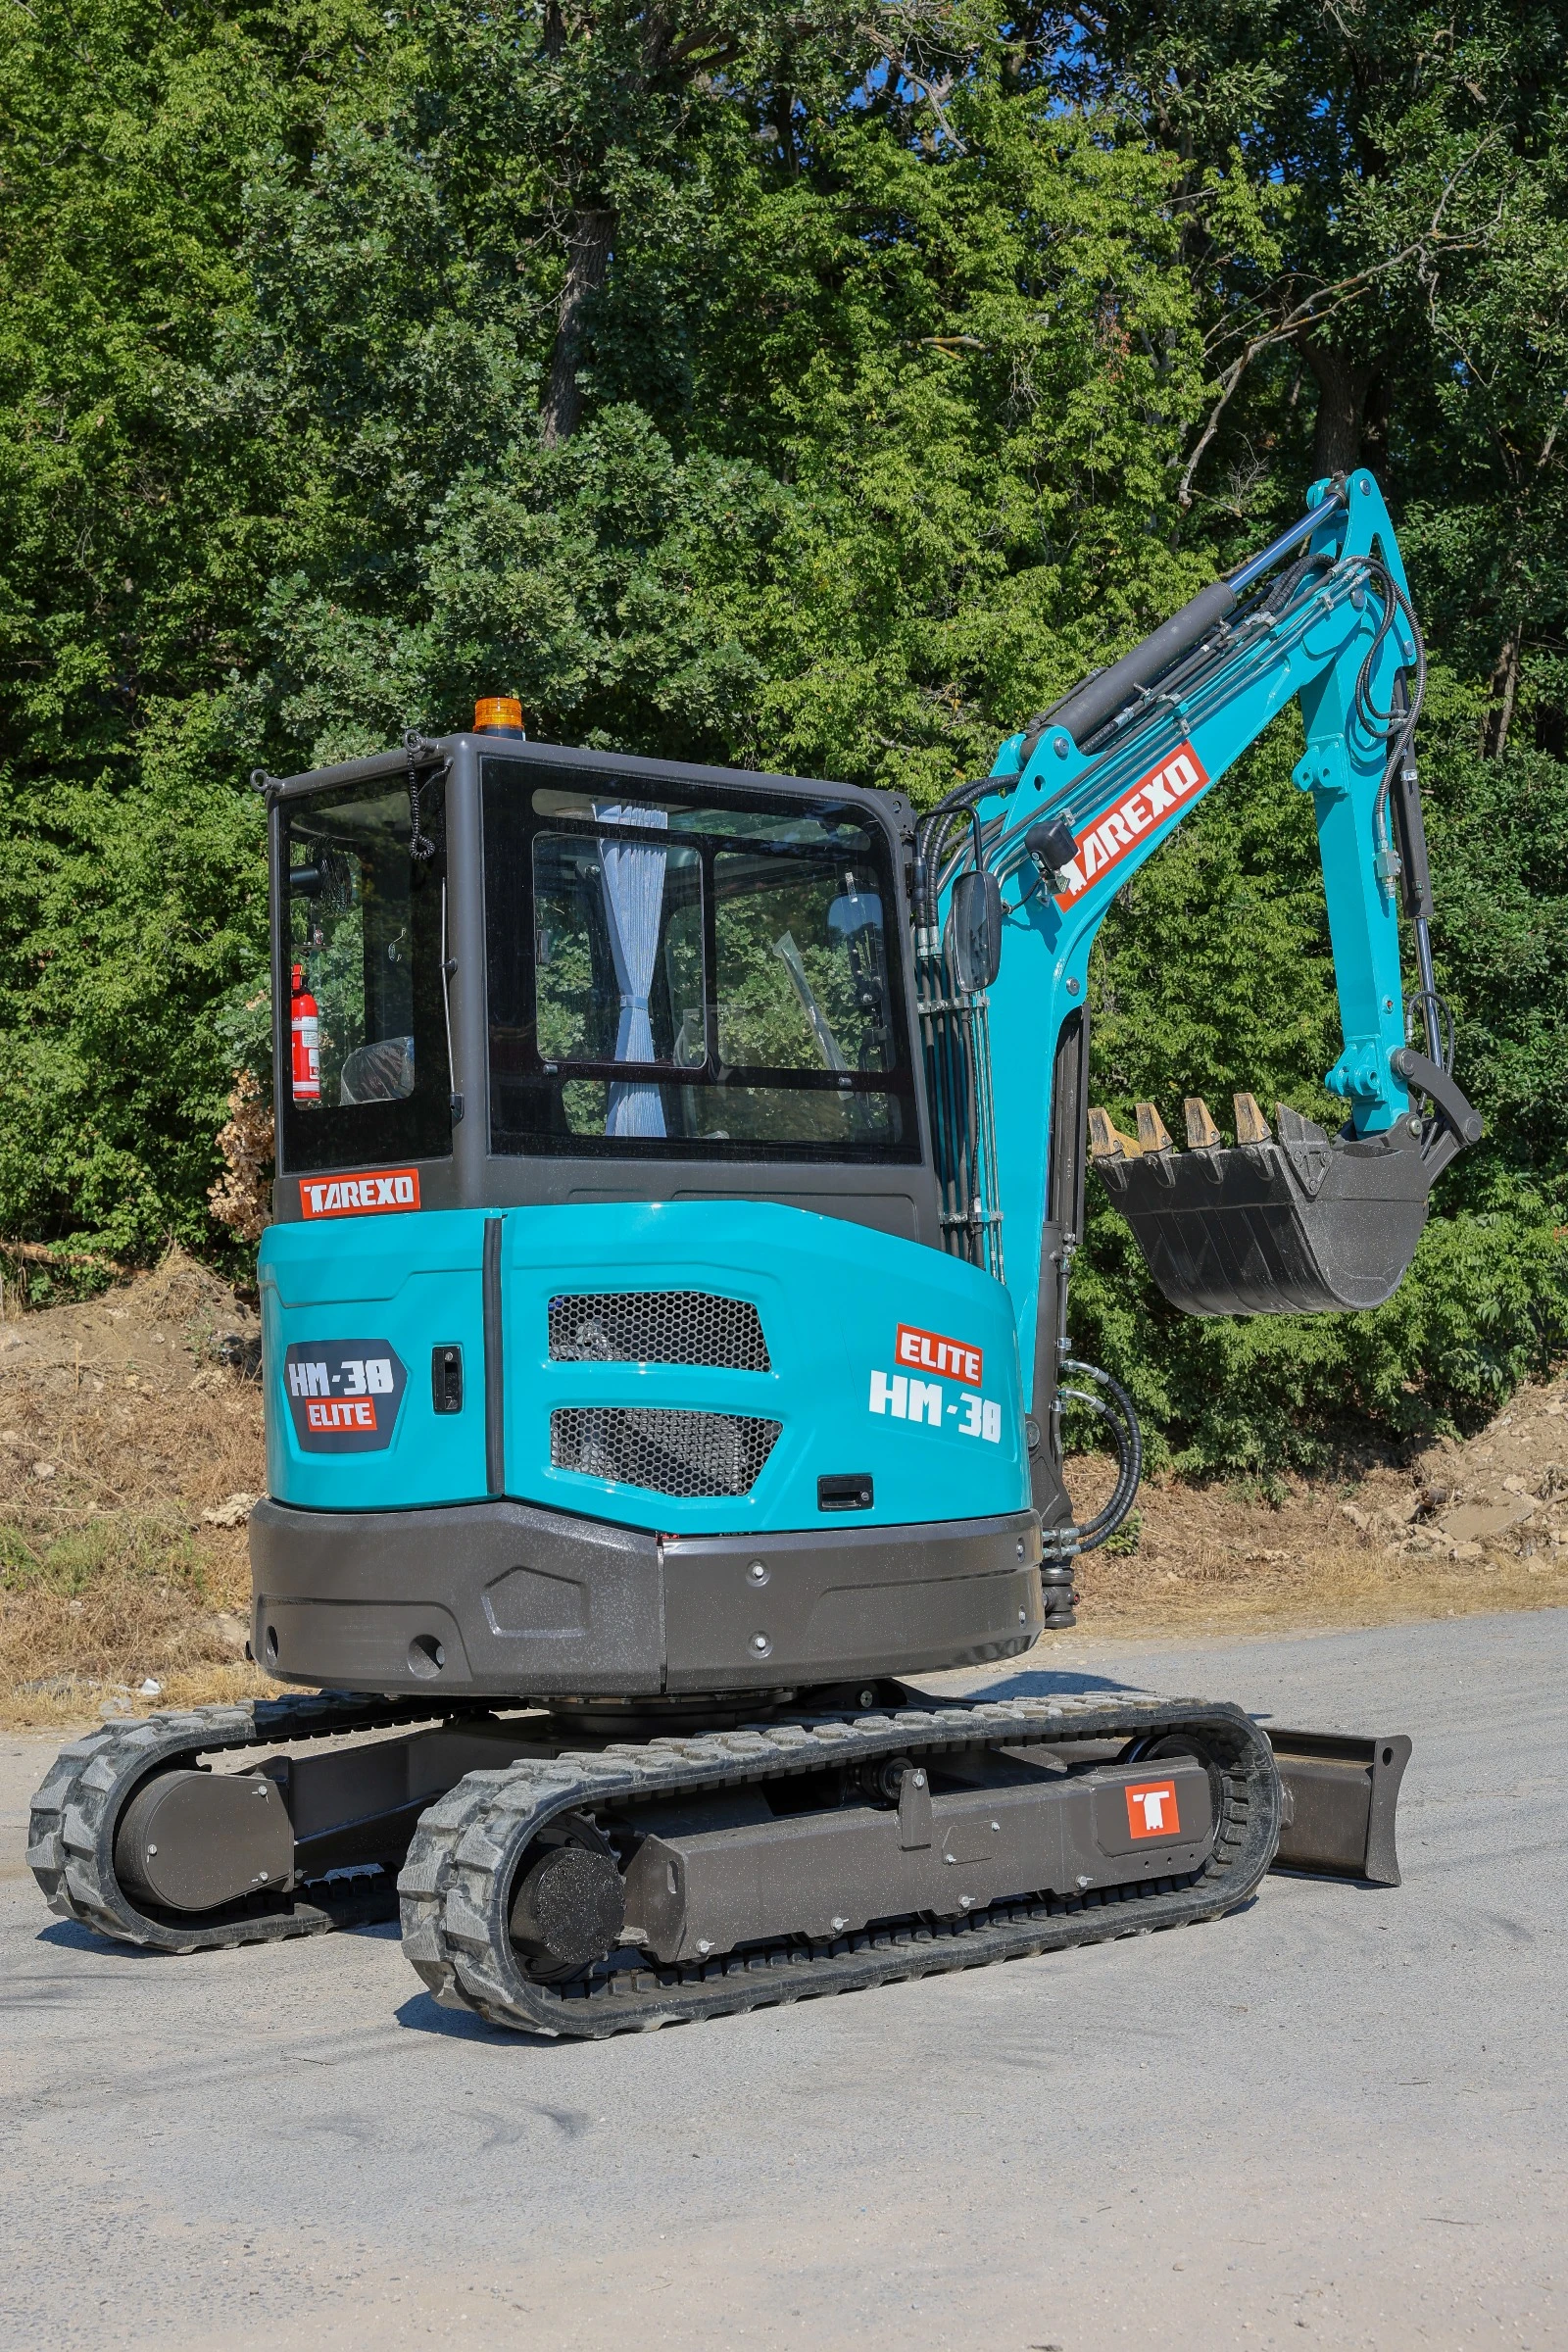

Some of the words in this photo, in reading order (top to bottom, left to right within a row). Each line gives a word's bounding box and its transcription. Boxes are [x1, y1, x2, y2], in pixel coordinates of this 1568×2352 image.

[304, 1176, 414, 1213] TAREXO
[900, 1332, 980, 1382] ELITE
[288, 1358, 394, 1396] HM-38
[308, 1402, 372, 1426] ELITE
[868, 1369, 1002, 1445] HM-38
